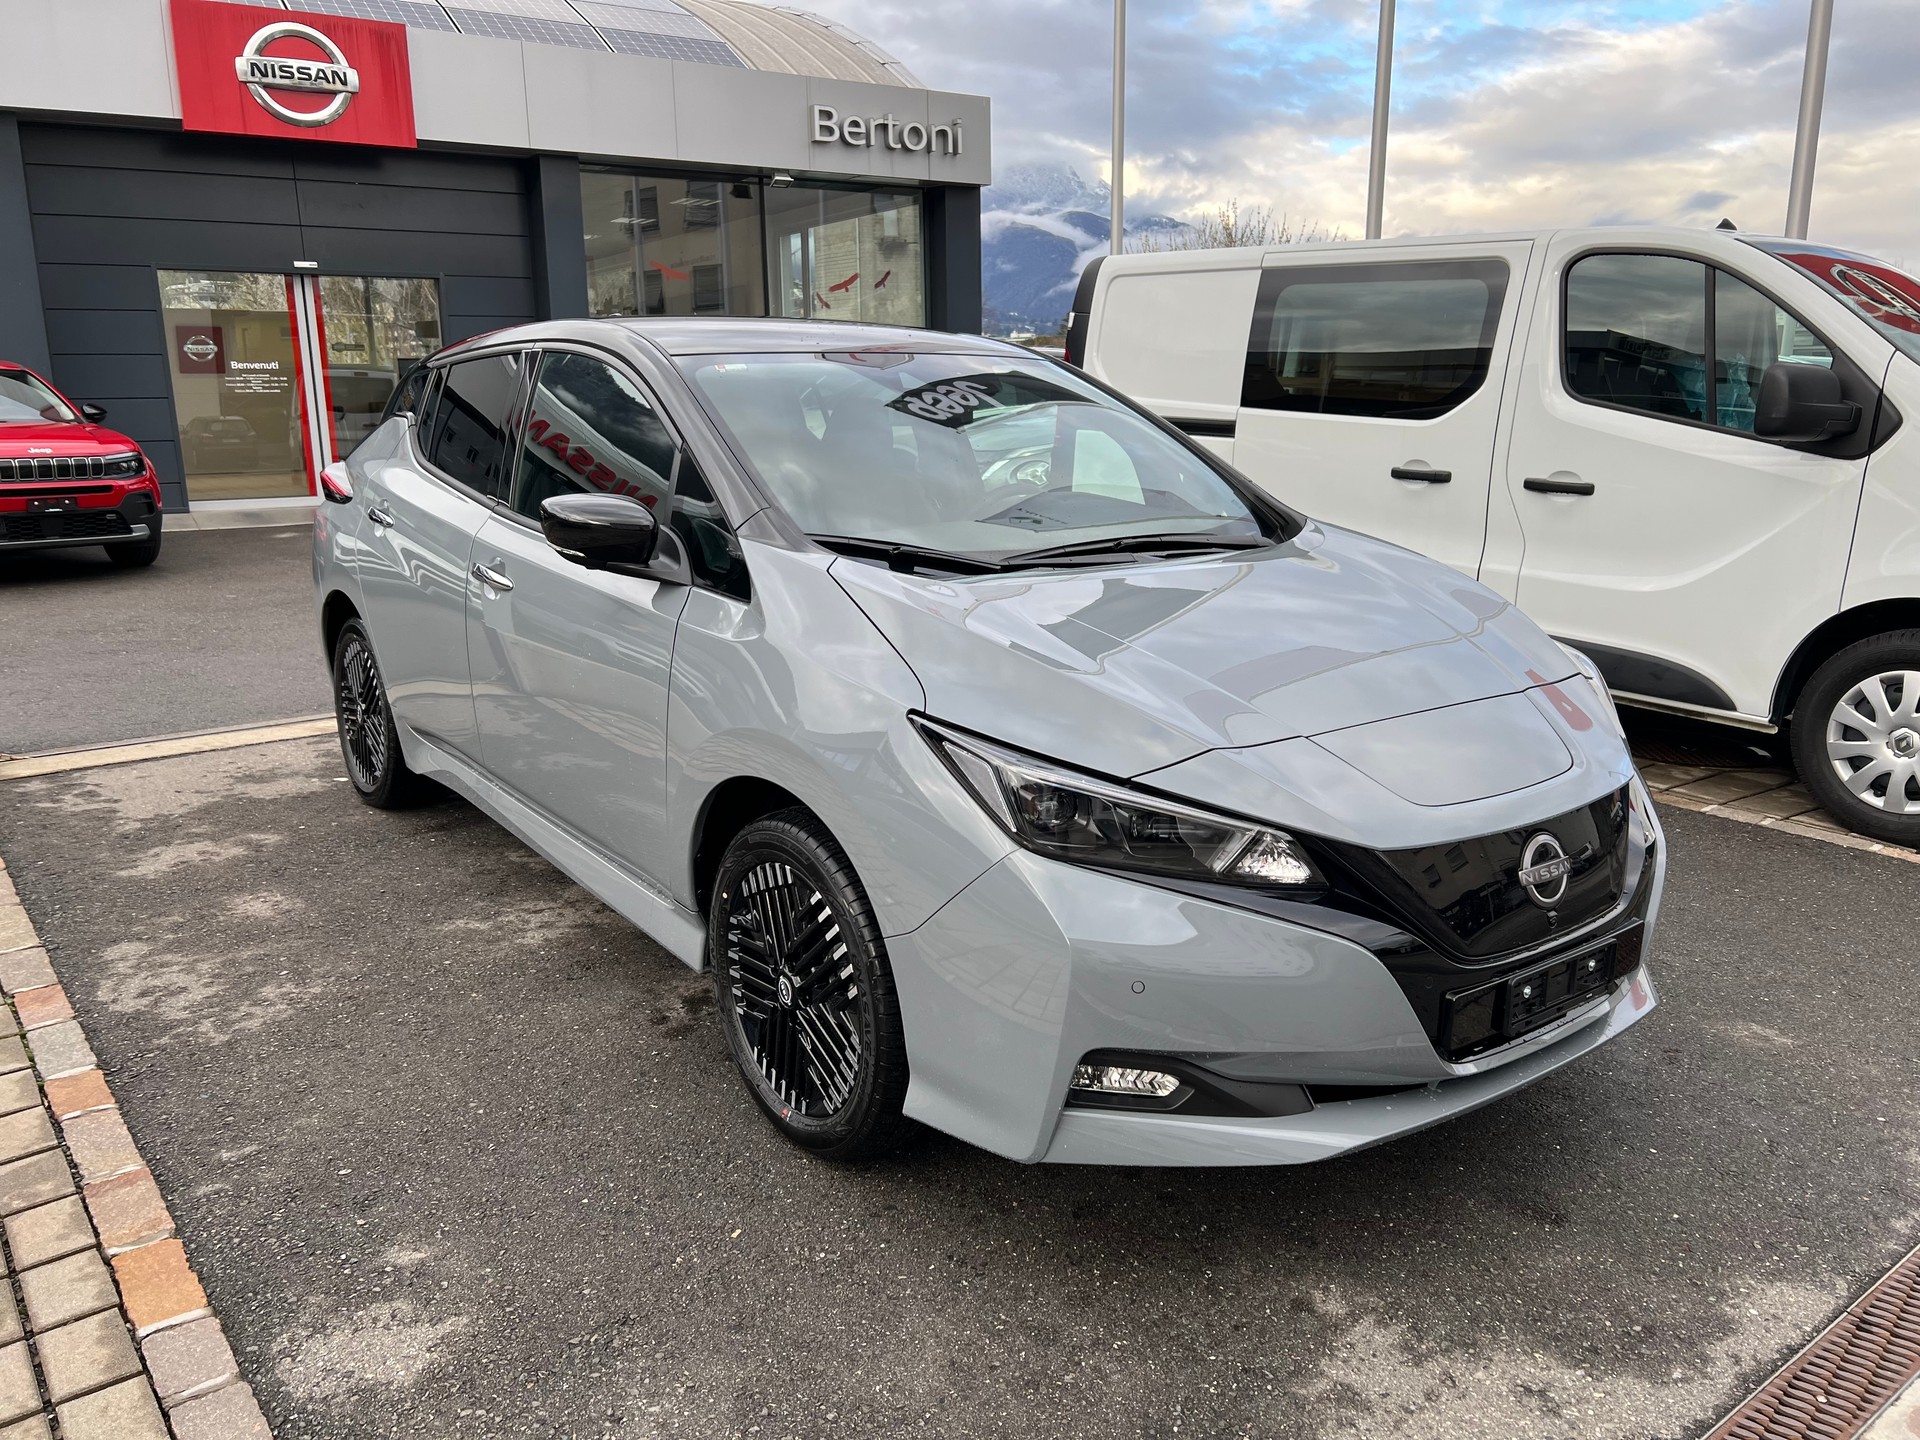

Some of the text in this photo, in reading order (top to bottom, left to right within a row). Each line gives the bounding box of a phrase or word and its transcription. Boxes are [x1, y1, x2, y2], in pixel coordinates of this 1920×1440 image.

[249, 61, 349, 87] NISSAN
[810, 104, 964, 156] Bertoni
[186, 345, 216, 353] NISSAN
[230, 360, 280, 370] Benvenuti
[1522, 860, 1571, 885] NISSAN
